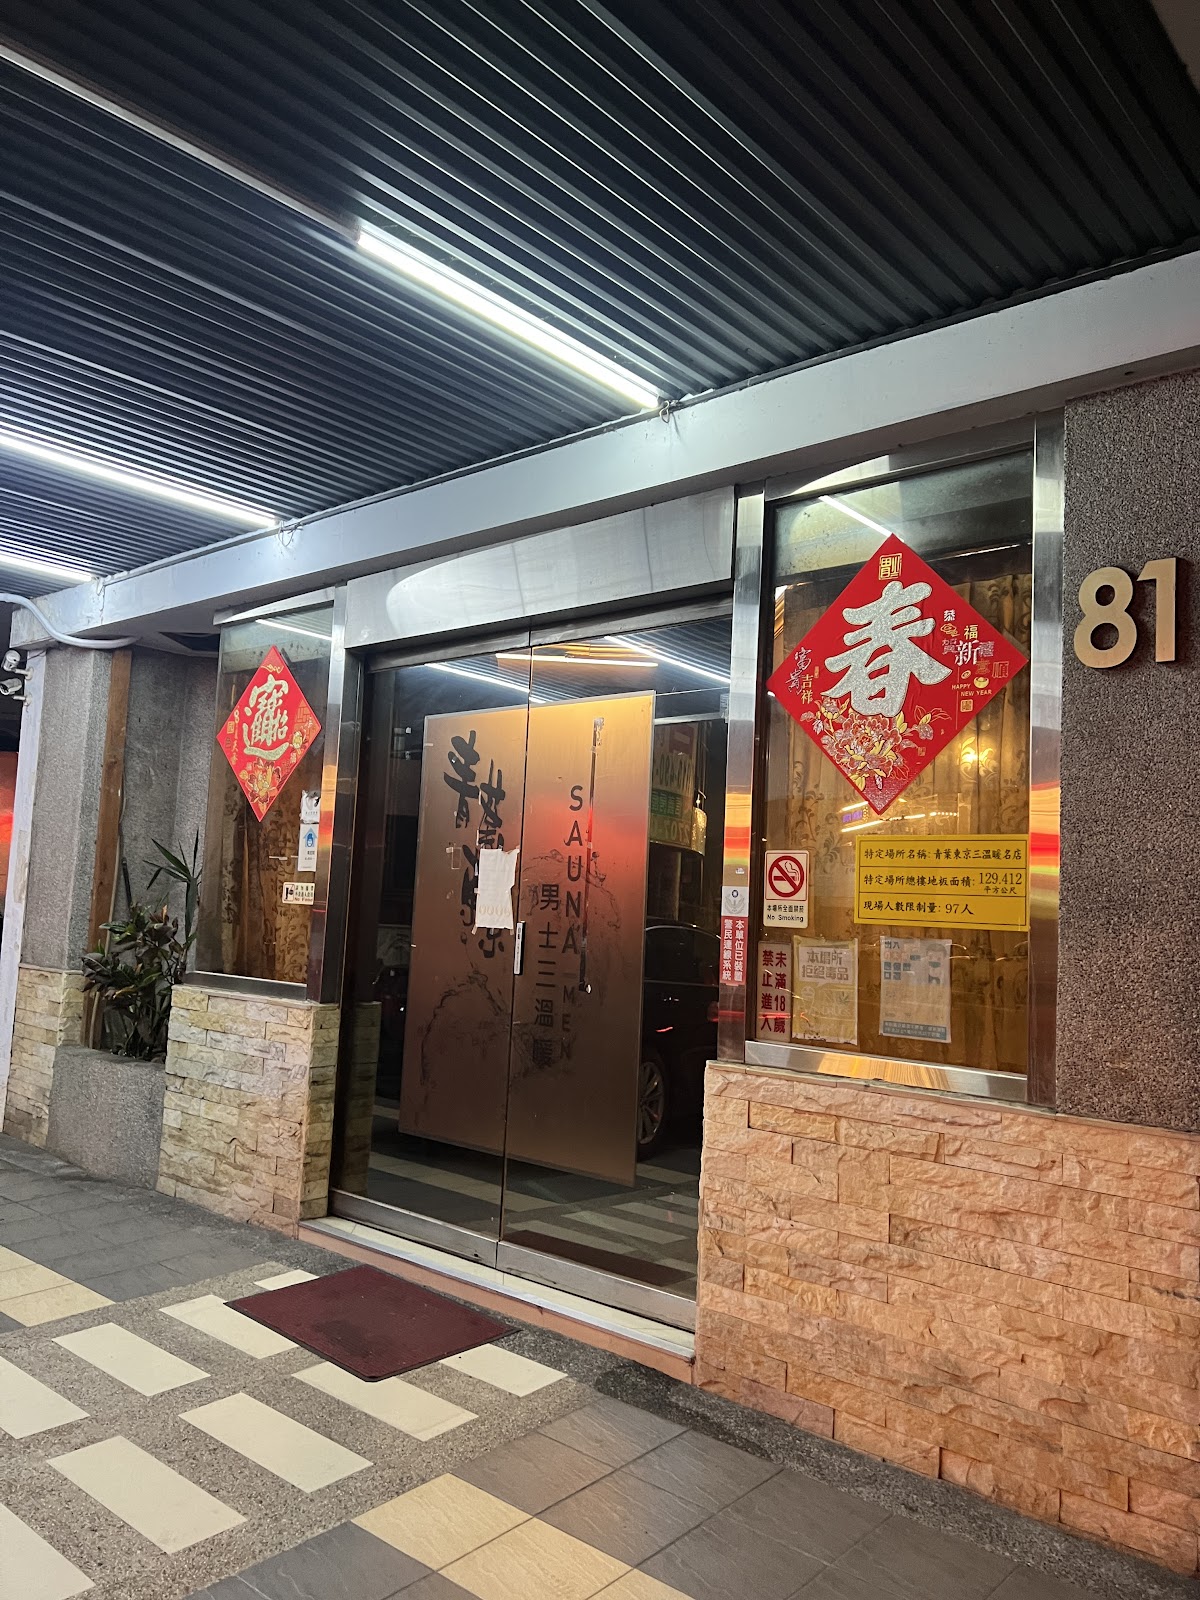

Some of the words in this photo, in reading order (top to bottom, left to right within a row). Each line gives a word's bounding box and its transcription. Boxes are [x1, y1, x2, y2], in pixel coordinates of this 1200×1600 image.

[1074, 557, 1177, 669] 81
[963, 624, 979, 640] 福
[820, 580, 952, 718] 春
[801, 674, 814, 704] 吉祥
[979, 872, 1022, 885] 129.412
[983, 886, 1017, 894] 平方公尺
[777, 914, 804, 923] Smoking
[734, 919, 745, 982] 本單位已裝置
[760, 949, 774, 1034] 禁止進入
